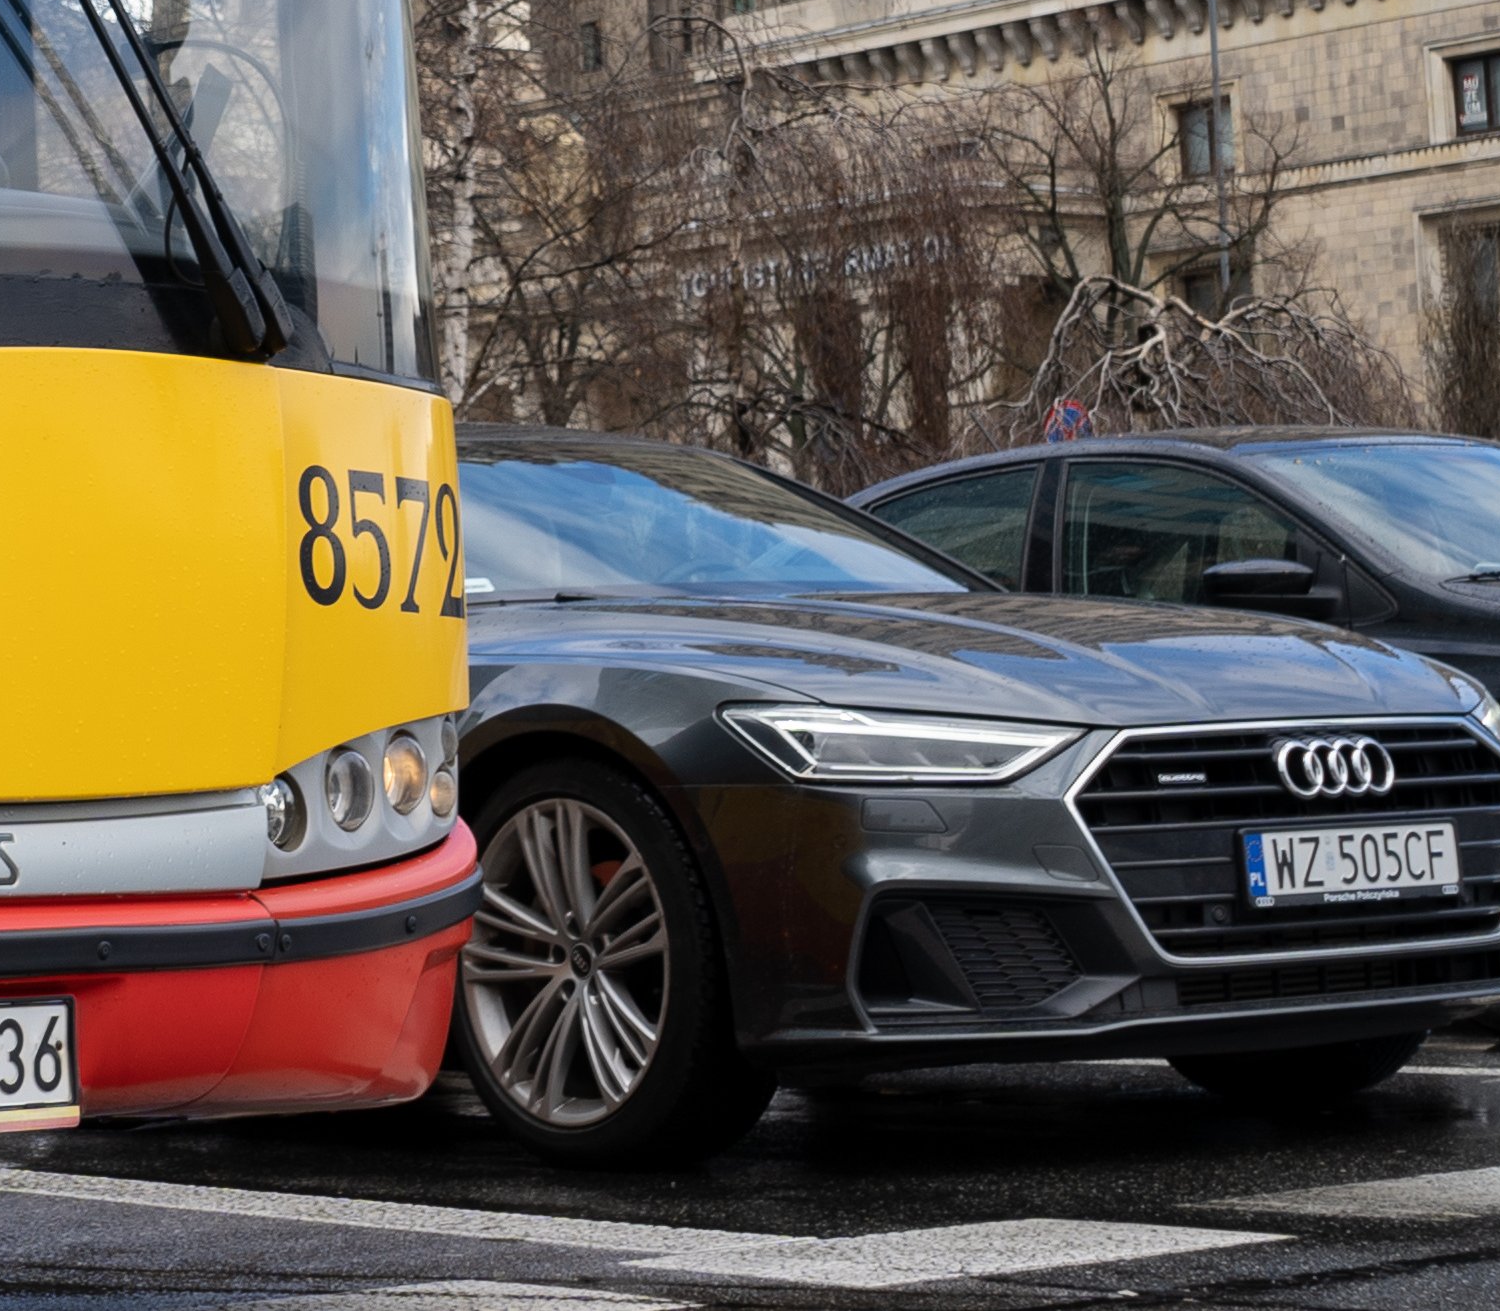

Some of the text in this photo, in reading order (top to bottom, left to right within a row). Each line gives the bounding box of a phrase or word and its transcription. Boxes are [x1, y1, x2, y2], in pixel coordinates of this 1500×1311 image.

[298, 464, 466, 619] 8572
[1250, 872, 1265, 887] PL
[1272, 829, 1444, 889] WZ 505CF
